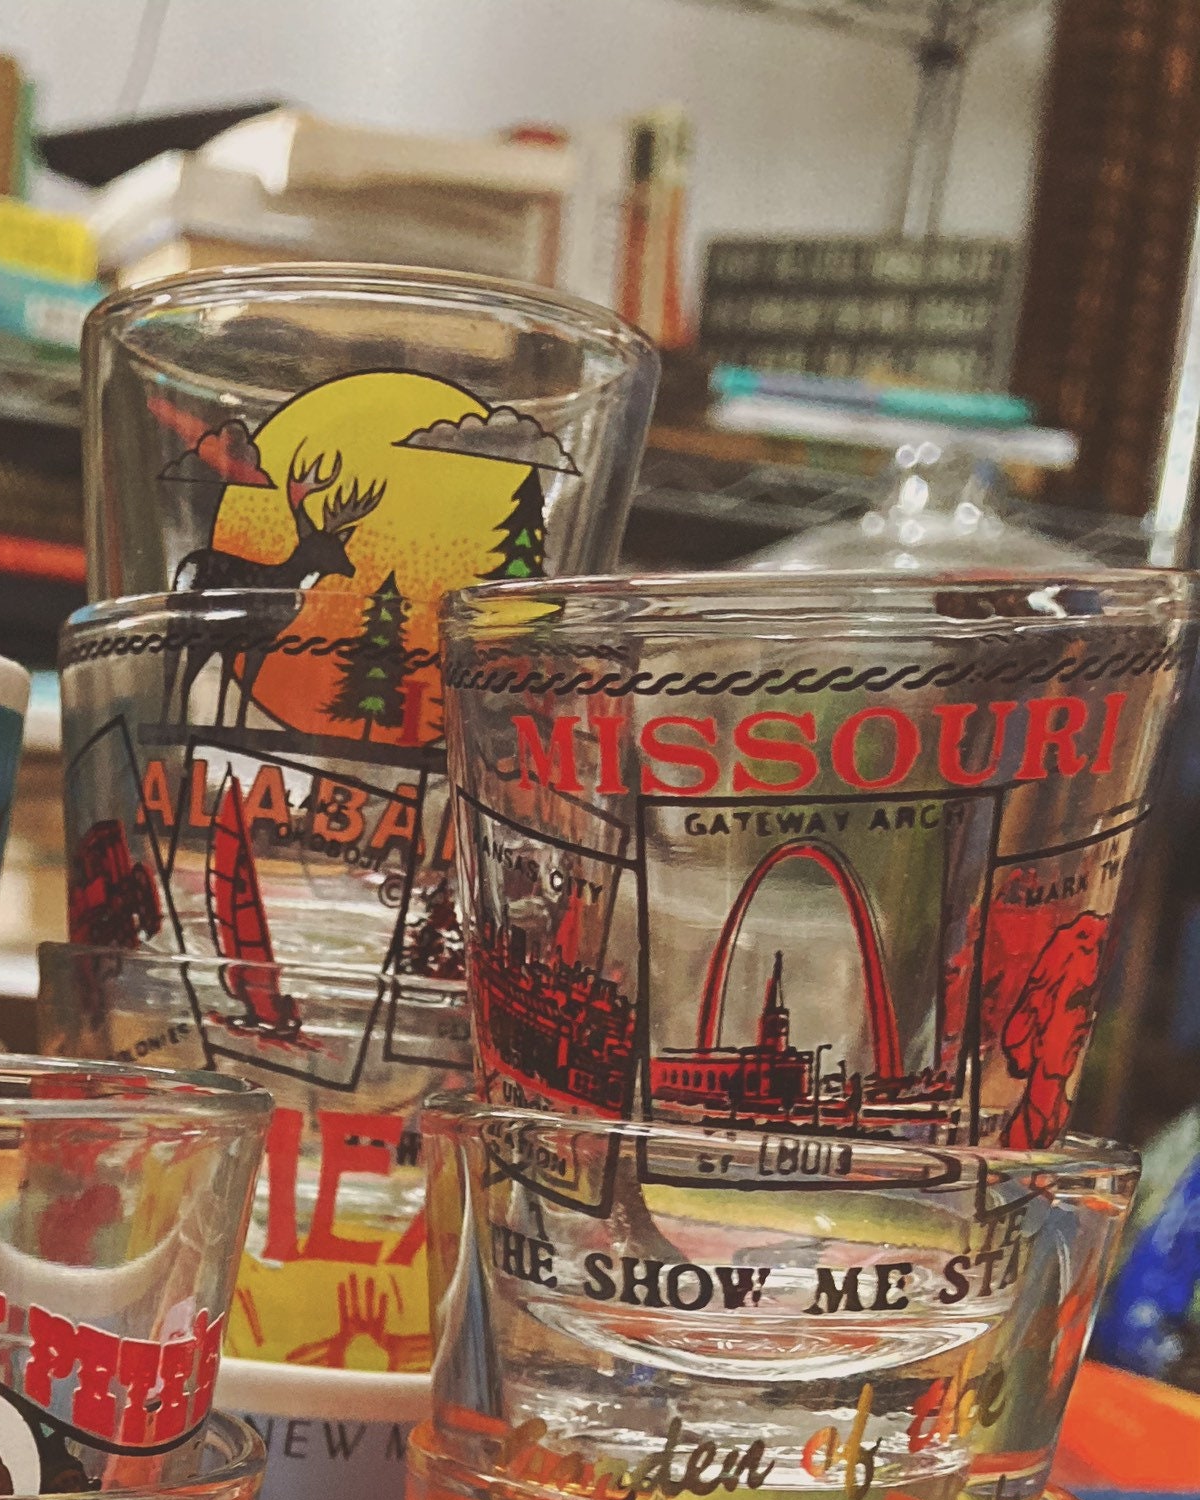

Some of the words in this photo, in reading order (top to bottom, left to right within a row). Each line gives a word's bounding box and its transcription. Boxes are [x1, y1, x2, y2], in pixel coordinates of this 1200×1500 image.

[511, 692, 1126, 799] MISSOURI
[684, 808, 848, 838] GATEWAY
[550, 869, 603, 904] CITY
[583, 1252, 771, 1311] SHOW
[803, 1262, 915, 1316] ME
